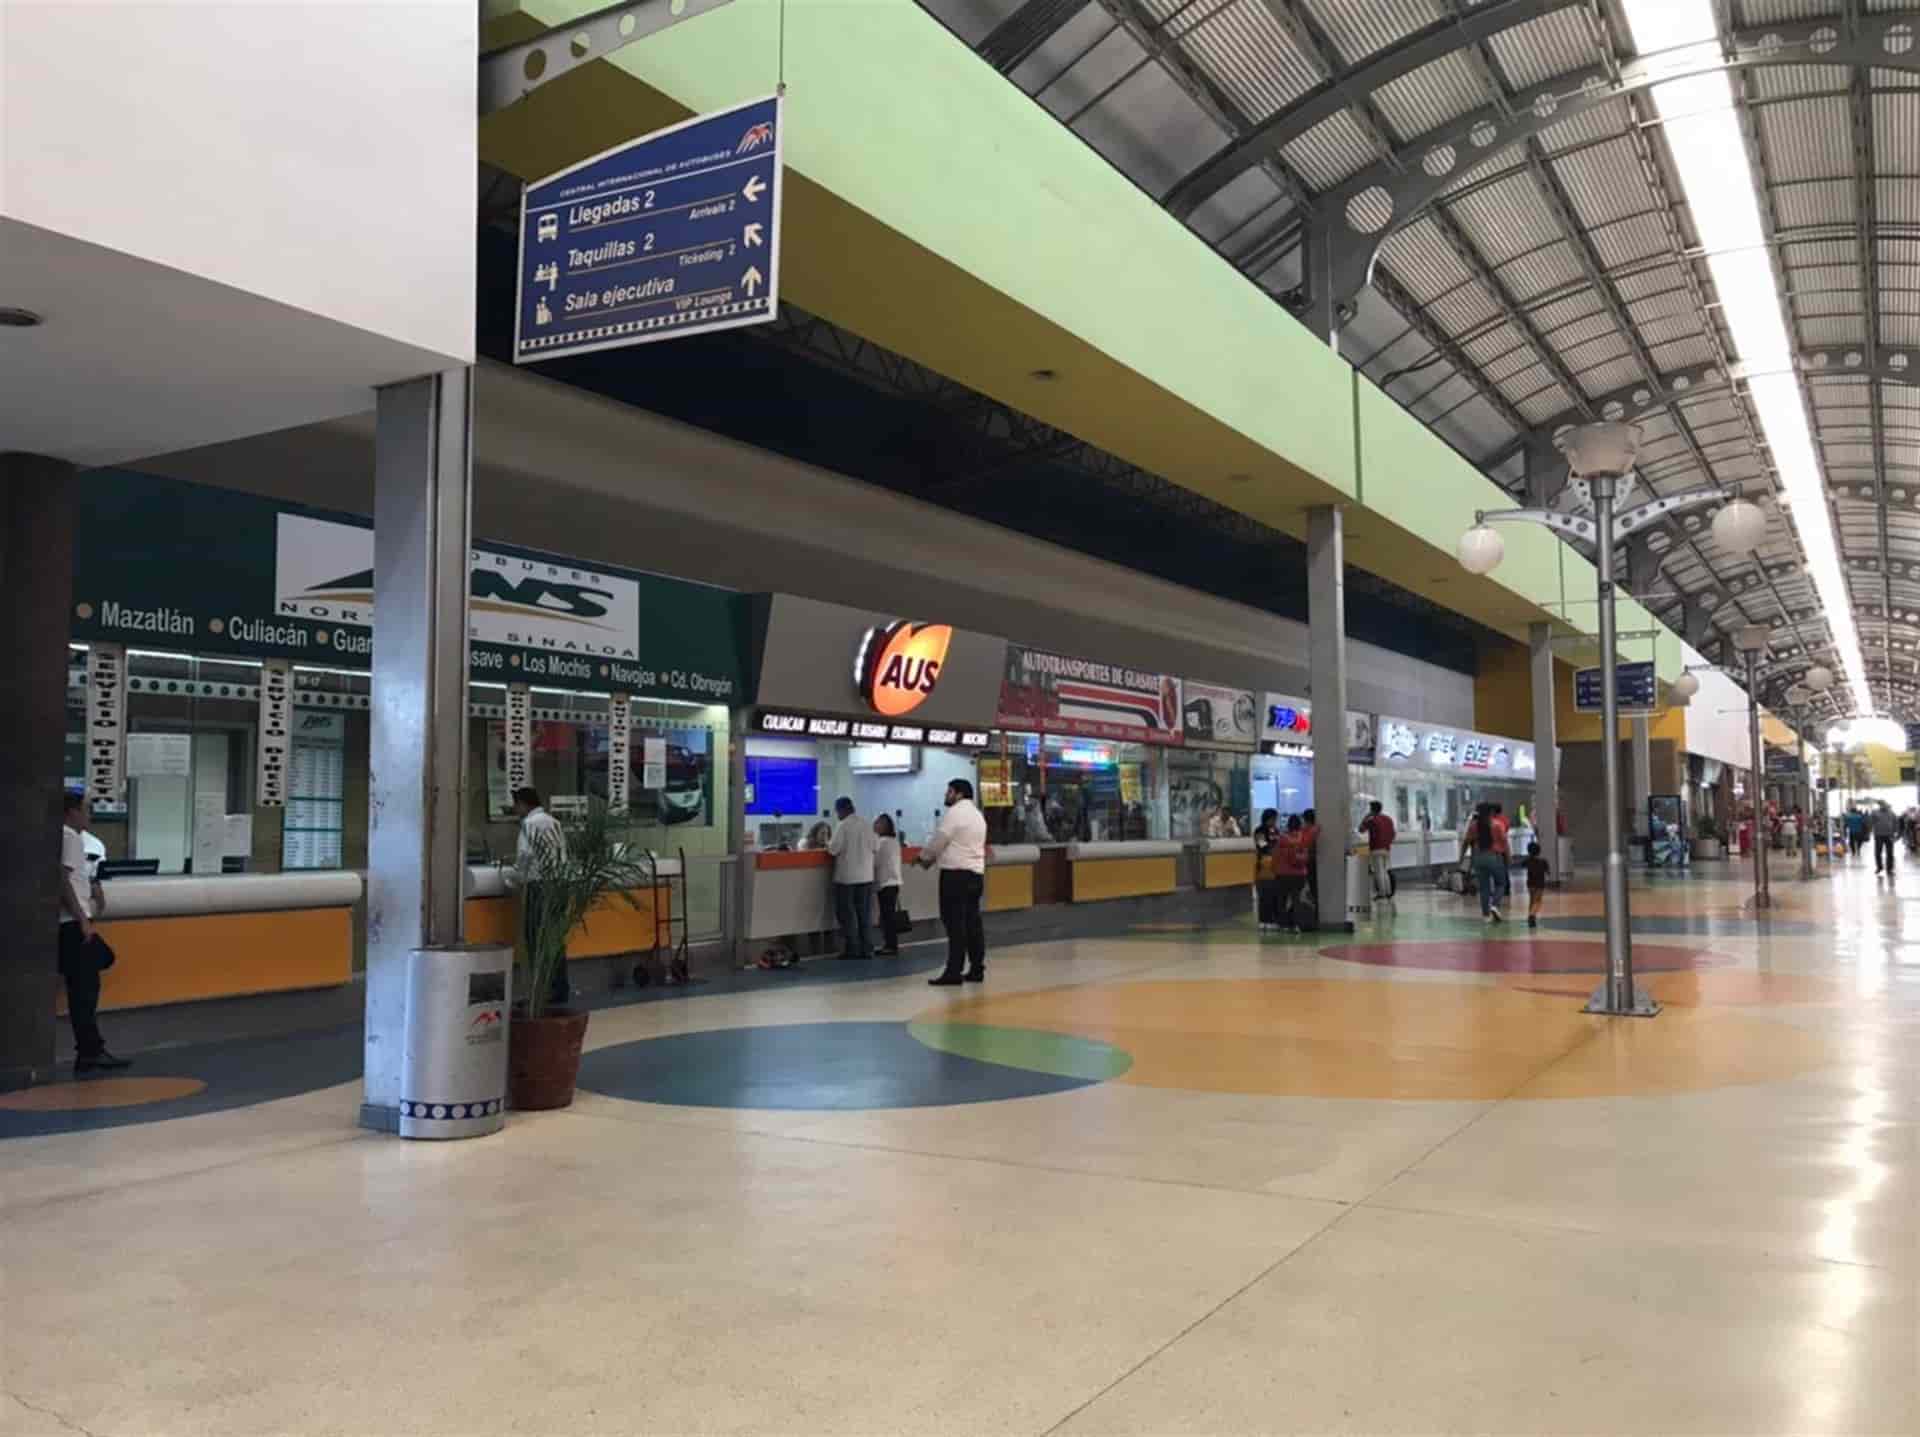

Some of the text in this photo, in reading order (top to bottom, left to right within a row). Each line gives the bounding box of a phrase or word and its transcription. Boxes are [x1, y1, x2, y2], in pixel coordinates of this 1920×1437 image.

[569, 190, 656, 225] Llegadas 2
[728, 199, 736, 212] 2
[567, 233, 655, 268] Taquillas 2
[679, 243, 736, 266] Ticketing 2
[564, 277, 675, 312] Sala ejecutiva
[101, 601, 194, 635] Mazatlán
[228, 616, 308, 646] Culiacán
[507, 632, 635, 658] SINALOA
[522, 651, 546, 674] Los
[550, 655, 592, 679] Mochis
[611, 663, 656, 688] Navojoa
[670, 669, 689, 690] Cd.
[691, 674, 733, 697] Obregón
[880, 653, 939, 694] AUS
[1023, 650, 1110, 682] AUTOTRANSPORTES
[1112, 666, 1124, 686] DE
